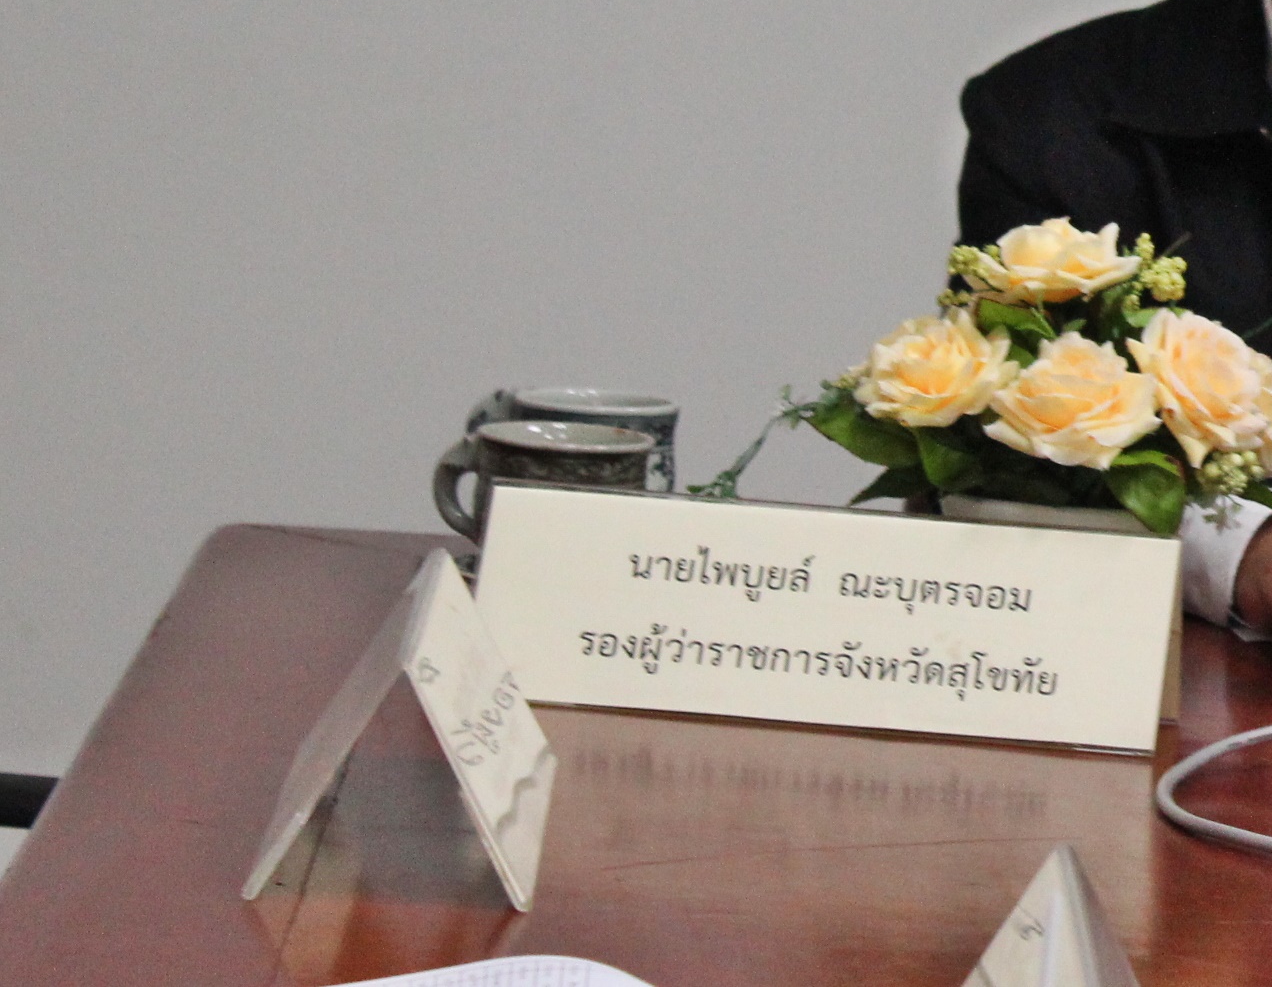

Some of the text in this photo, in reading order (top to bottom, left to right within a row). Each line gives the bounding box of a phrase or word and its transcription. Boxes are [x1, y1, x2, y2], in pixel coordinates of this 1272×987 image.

[839, 571, 1033, 615] ณะบุตรจอม
[579, 622, 1058, 701] รองผู้ว่าราชการจังหวัดสุโขทัย
